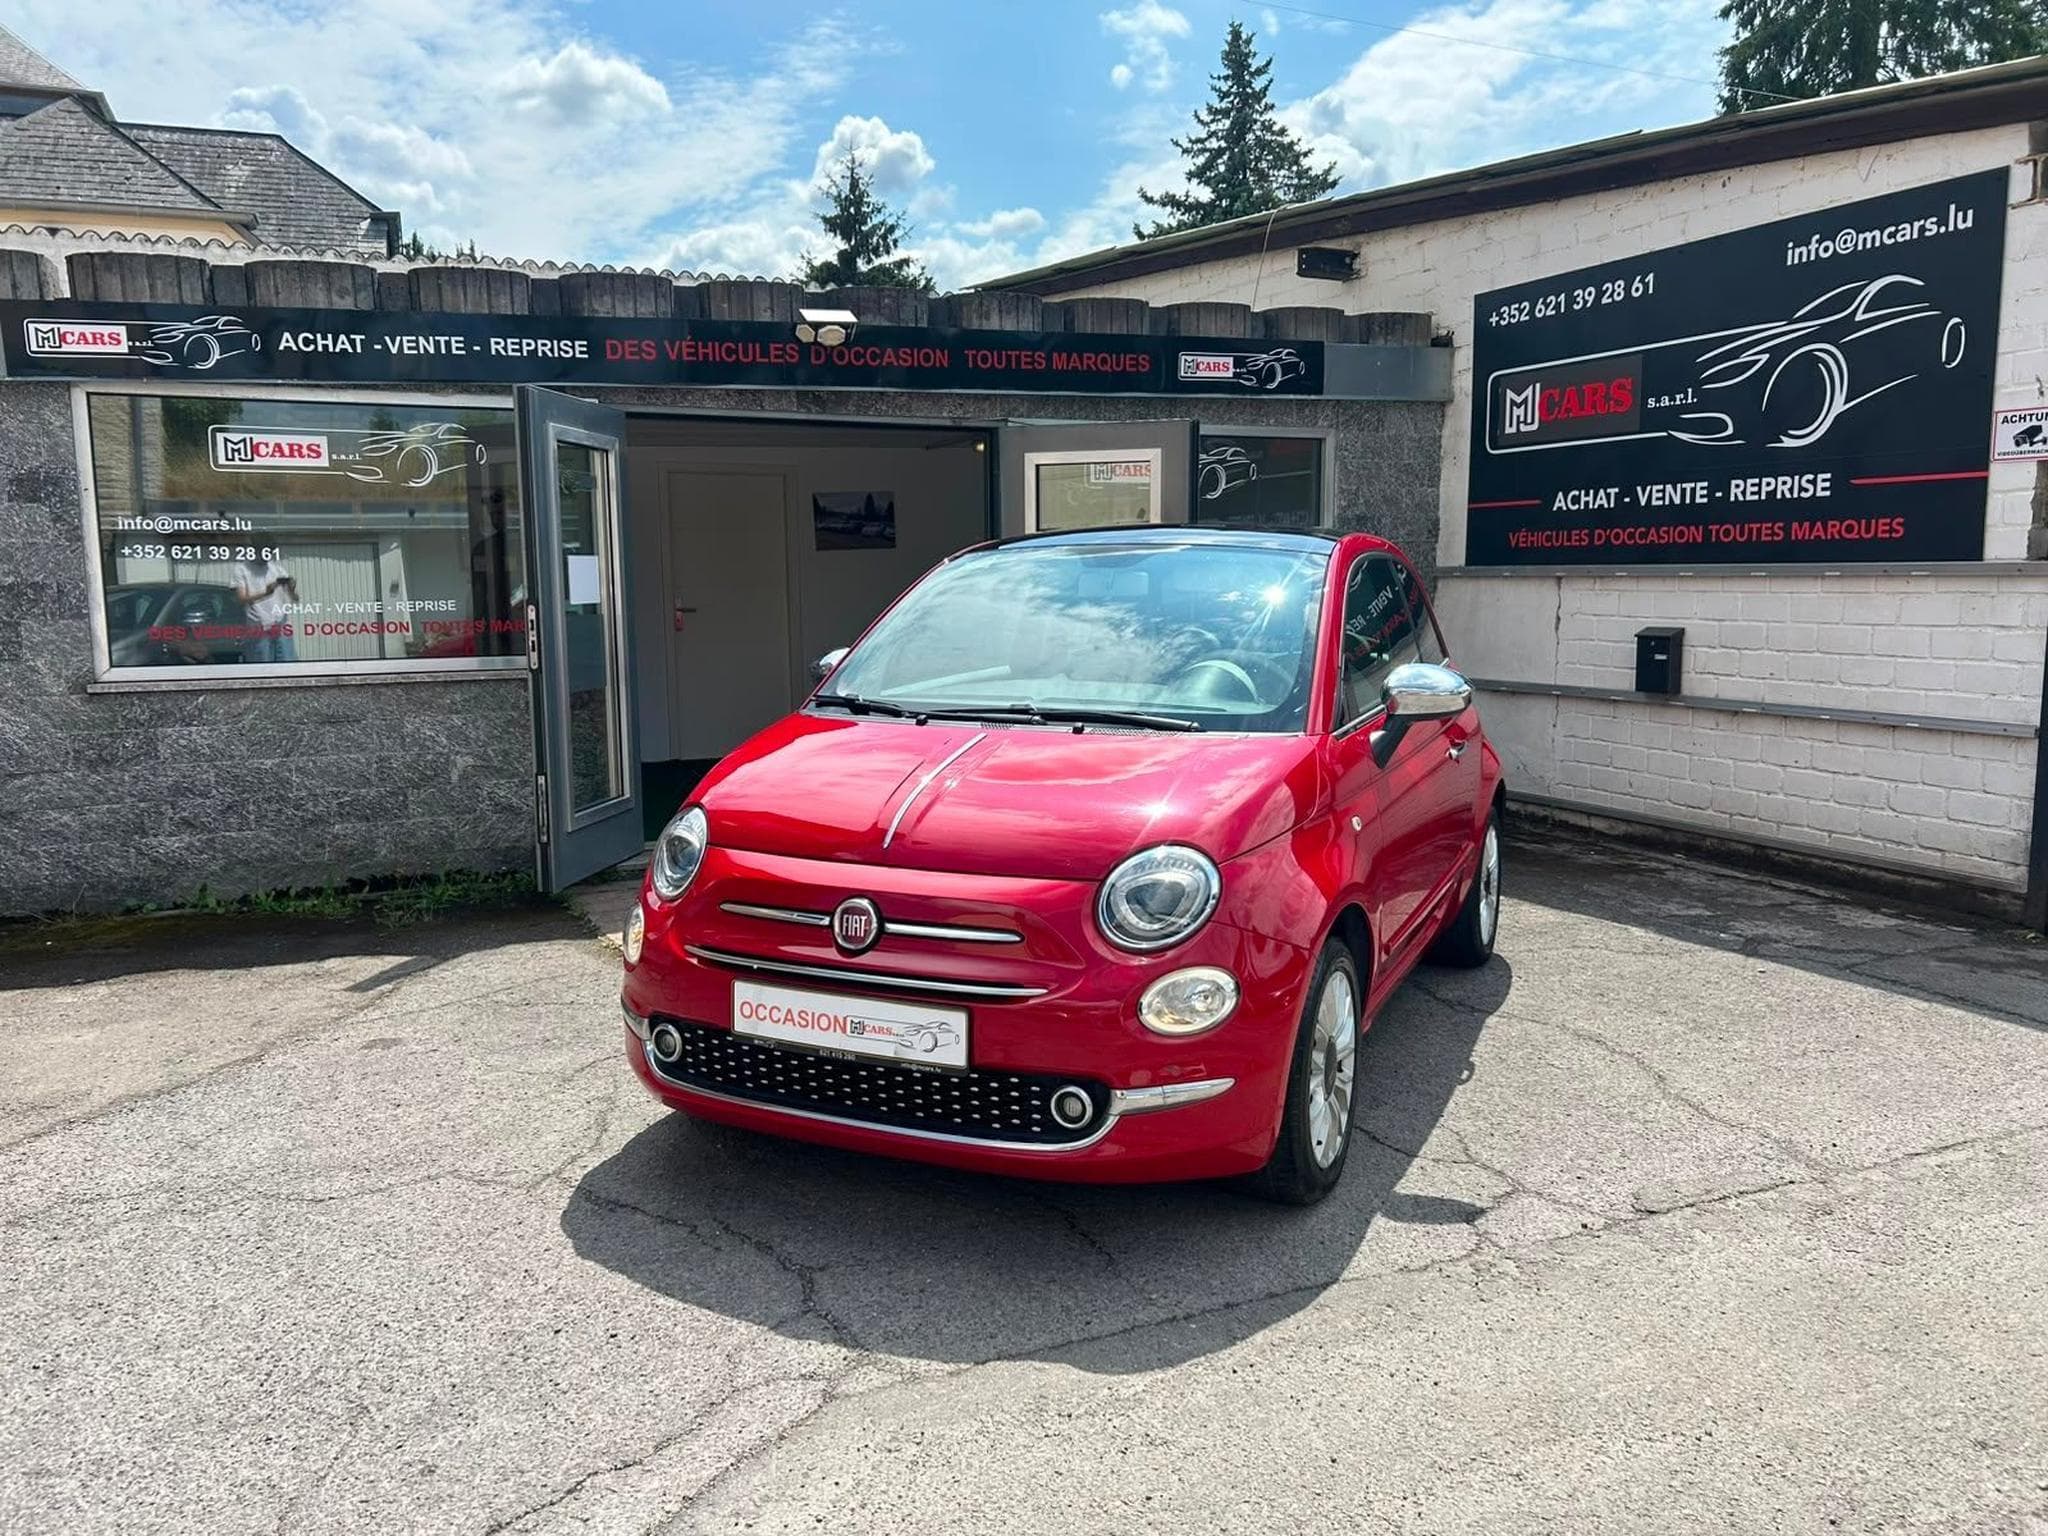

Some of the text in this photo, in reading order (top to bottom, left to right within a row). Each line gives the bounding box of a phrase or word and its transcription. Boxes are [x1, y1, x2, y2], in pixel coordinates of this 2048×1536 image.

[1786, 204, 1974, 266] info@mcars.lu
[1489, 272, 1655, 327] +352 621 39 28 61
[278, 332, 366, 353] ACHAT
[490, 337, 589, 359] REPRISE
[605, 339, 657, 361] DES
[664, 334, 799, 364] VÉHICULES
[810, 345, 948, 368] D'OCCASION
[965, 349, 1046, 371] TOUTES
[1052, 351, 1150, 373] MARQUES
[1647, 387, 1698, 409] s.a.r.l.
[1552, 487, 1619, 512] ACHAT
[1637, 481, 1709, 507] VENTE
[1729, 473, 1832, 502] REPRISE
[118, 516, 252, 534] info@mcars.lu
[1508, 516, 1905, 549] VÉHICULES D'OCCASION TOUTES MARQUES
[121, 544, 281, 561] +352 621 39 28 61
[271, 603, 323, 615] ACHAT
[335, 601, 383, 614] VENTE
[396, 600, 457, 613] REPRISE
[148, 625, 188, 641] DES
[304, 620, 410, 636] D'OCCASION
[421, 618, 484, 634] TOUTES
[842, 914, 868, 937] FIAT
[739, 1001, 847, 1034] OCCASION
